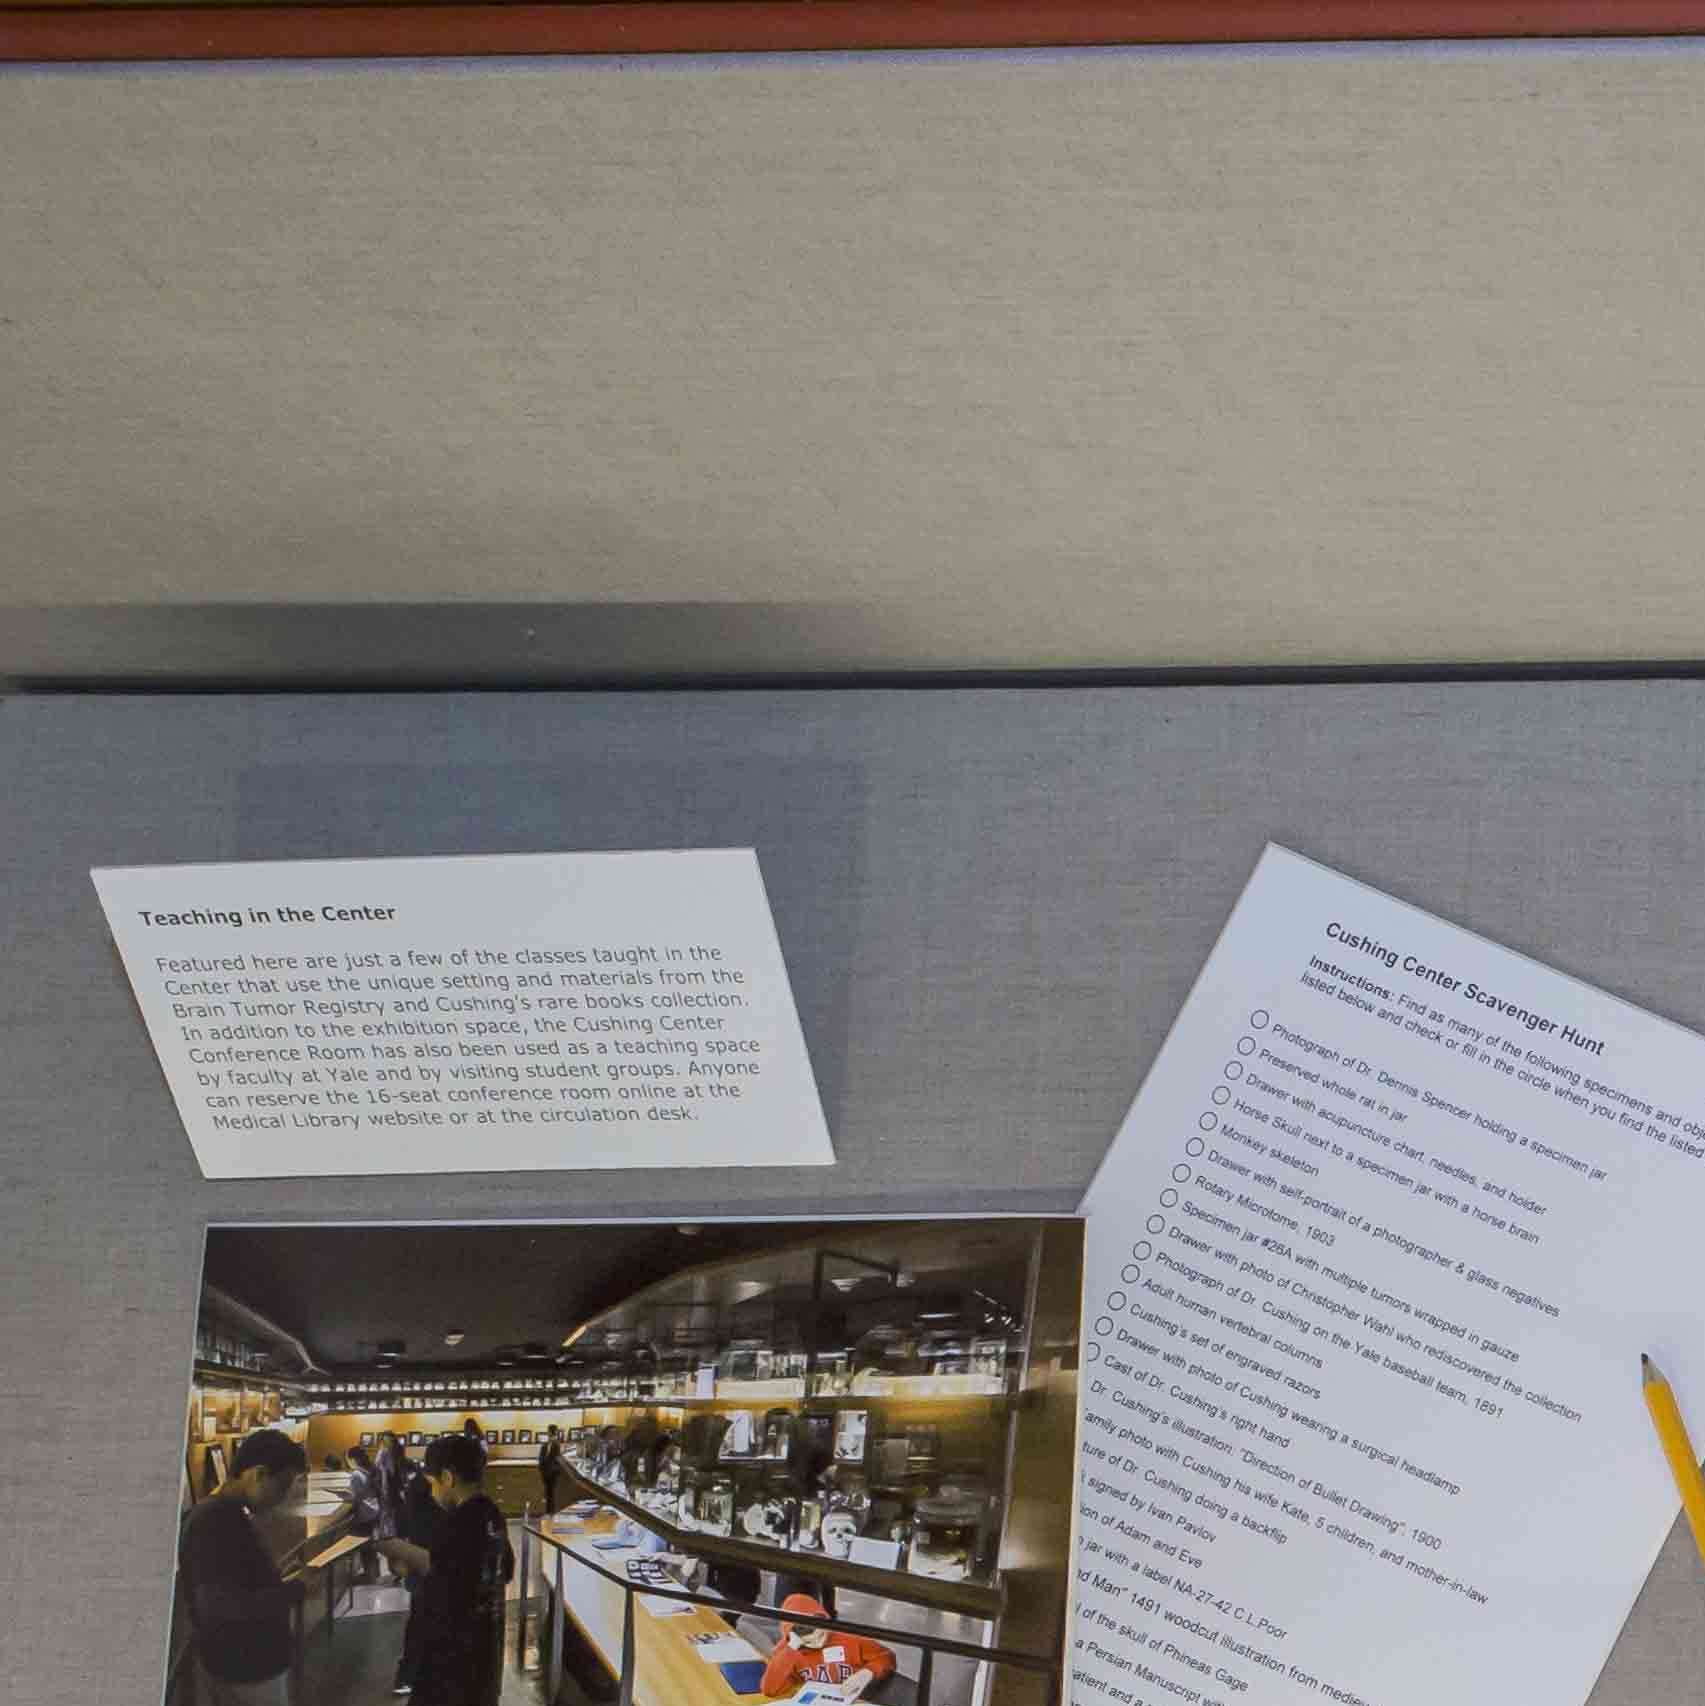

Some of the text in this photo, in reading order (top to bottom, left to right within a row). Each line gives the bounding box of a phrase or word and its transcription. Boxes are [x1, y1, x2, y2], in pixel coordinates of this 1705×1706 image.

[137, 905, 395, 927] Teaching in the Center
[154, 945, 722, 973] Featured here are just a few of the classes taught in the
[1326, 922, 1604, 1056] Cushing Center Scavenger Hunt
[1258, 1048, 1408, 1122] Preserved whole rat in jar
[1220, 1123, 1319, 1177] Monkey skeleton
[1074, 1639, 1084, 1649] a
[1085, 1642, 1133, 1672] Persian
[1133, 1664, 1201, 1704] Manuscript
